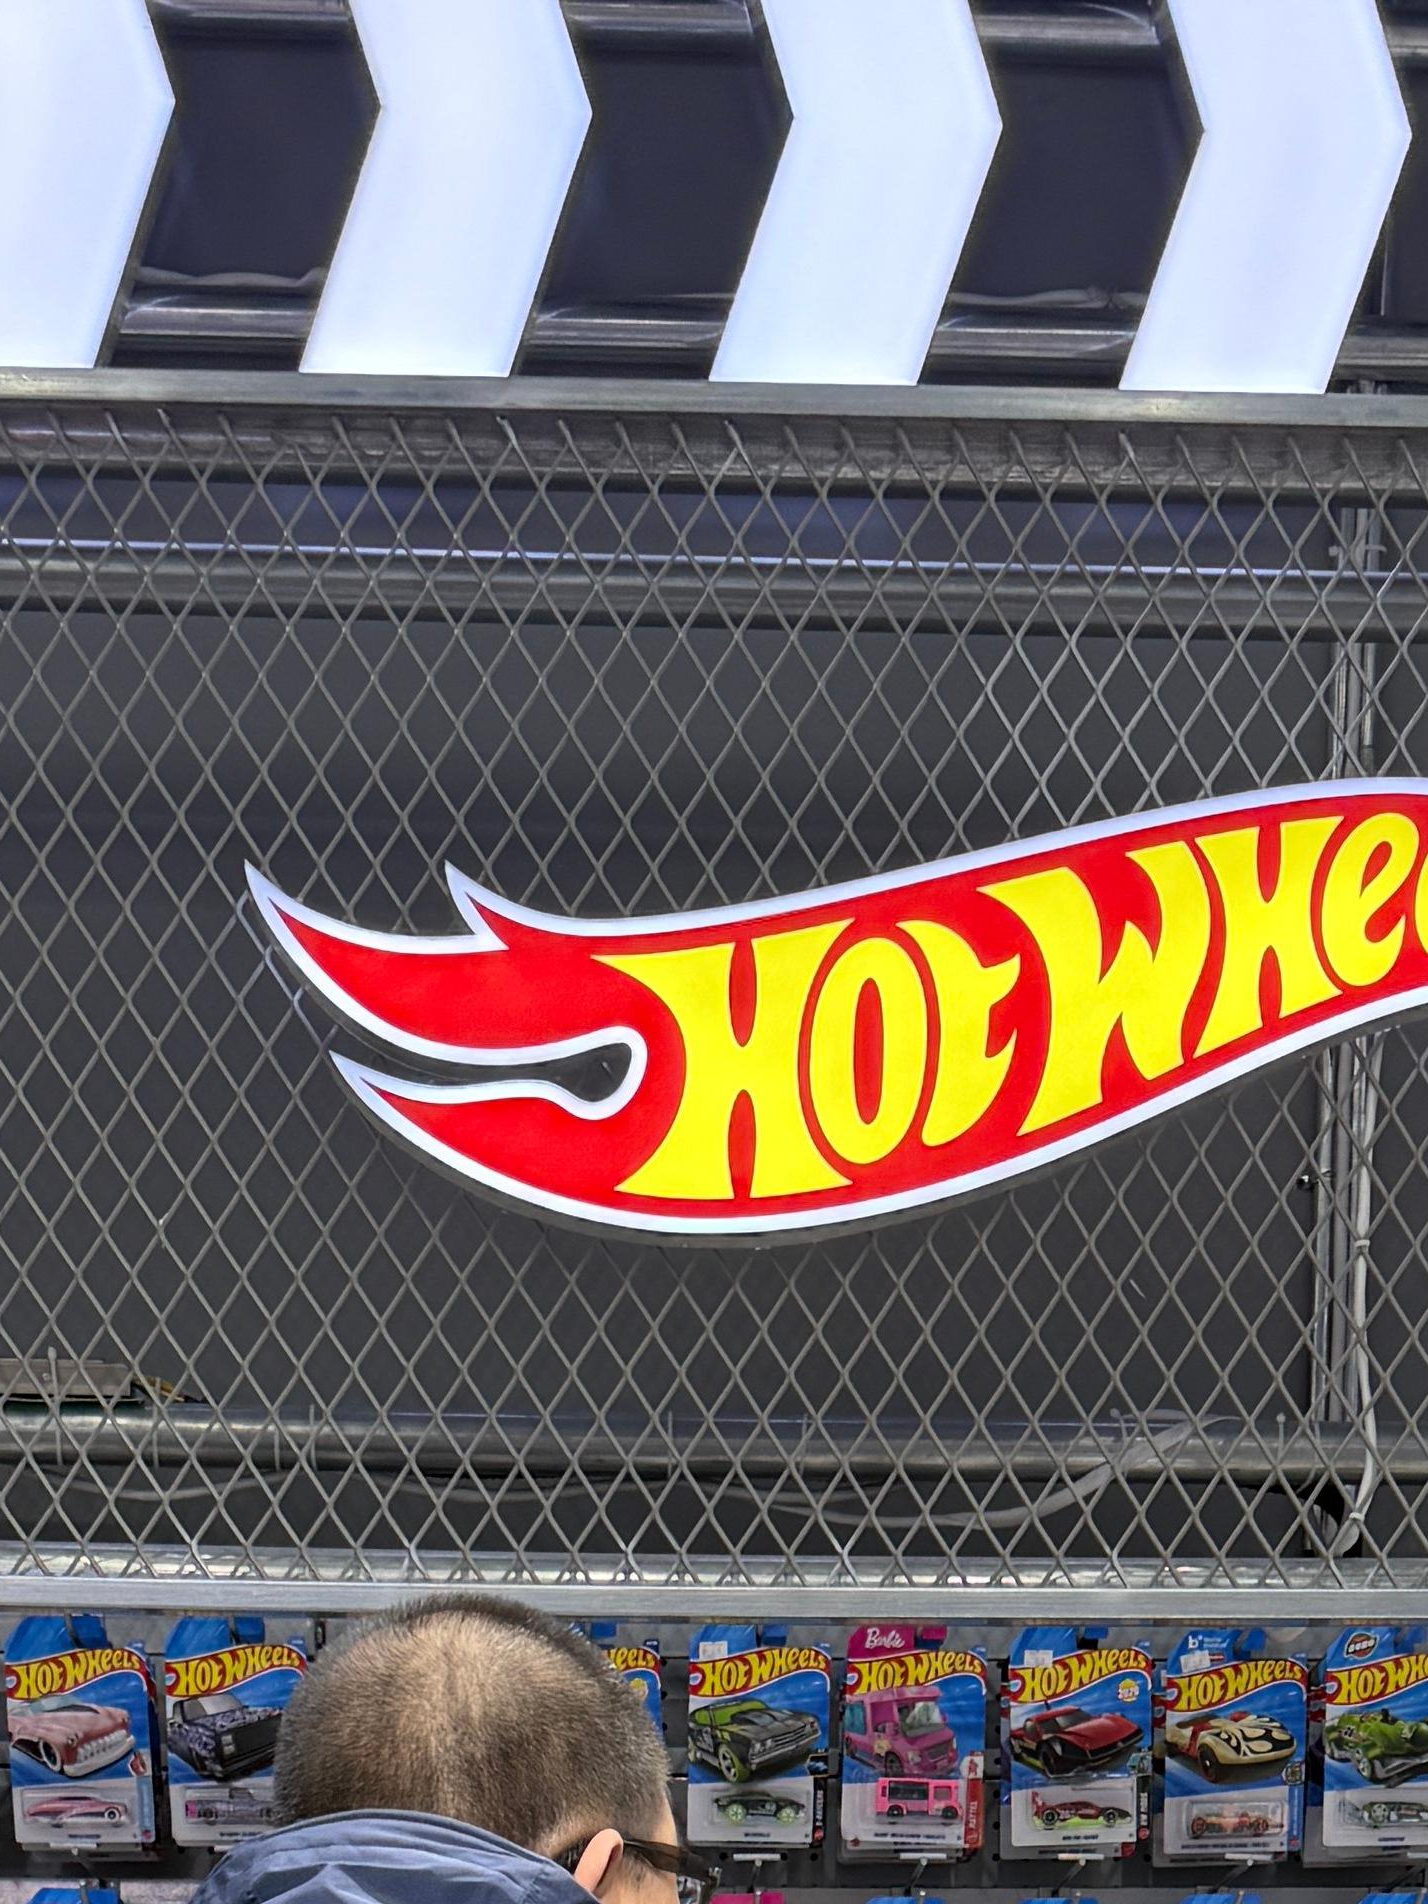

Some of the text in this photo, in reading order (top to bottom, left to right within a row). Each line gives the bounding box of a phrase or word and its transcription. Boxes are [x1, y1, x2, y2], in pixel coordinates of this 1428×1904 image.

[590, 918, 1022, 1200] HOT
[864, 1626, 906, 1649] Barbie
[1176, 1662, 1301, 1710] HOT WHEELS
